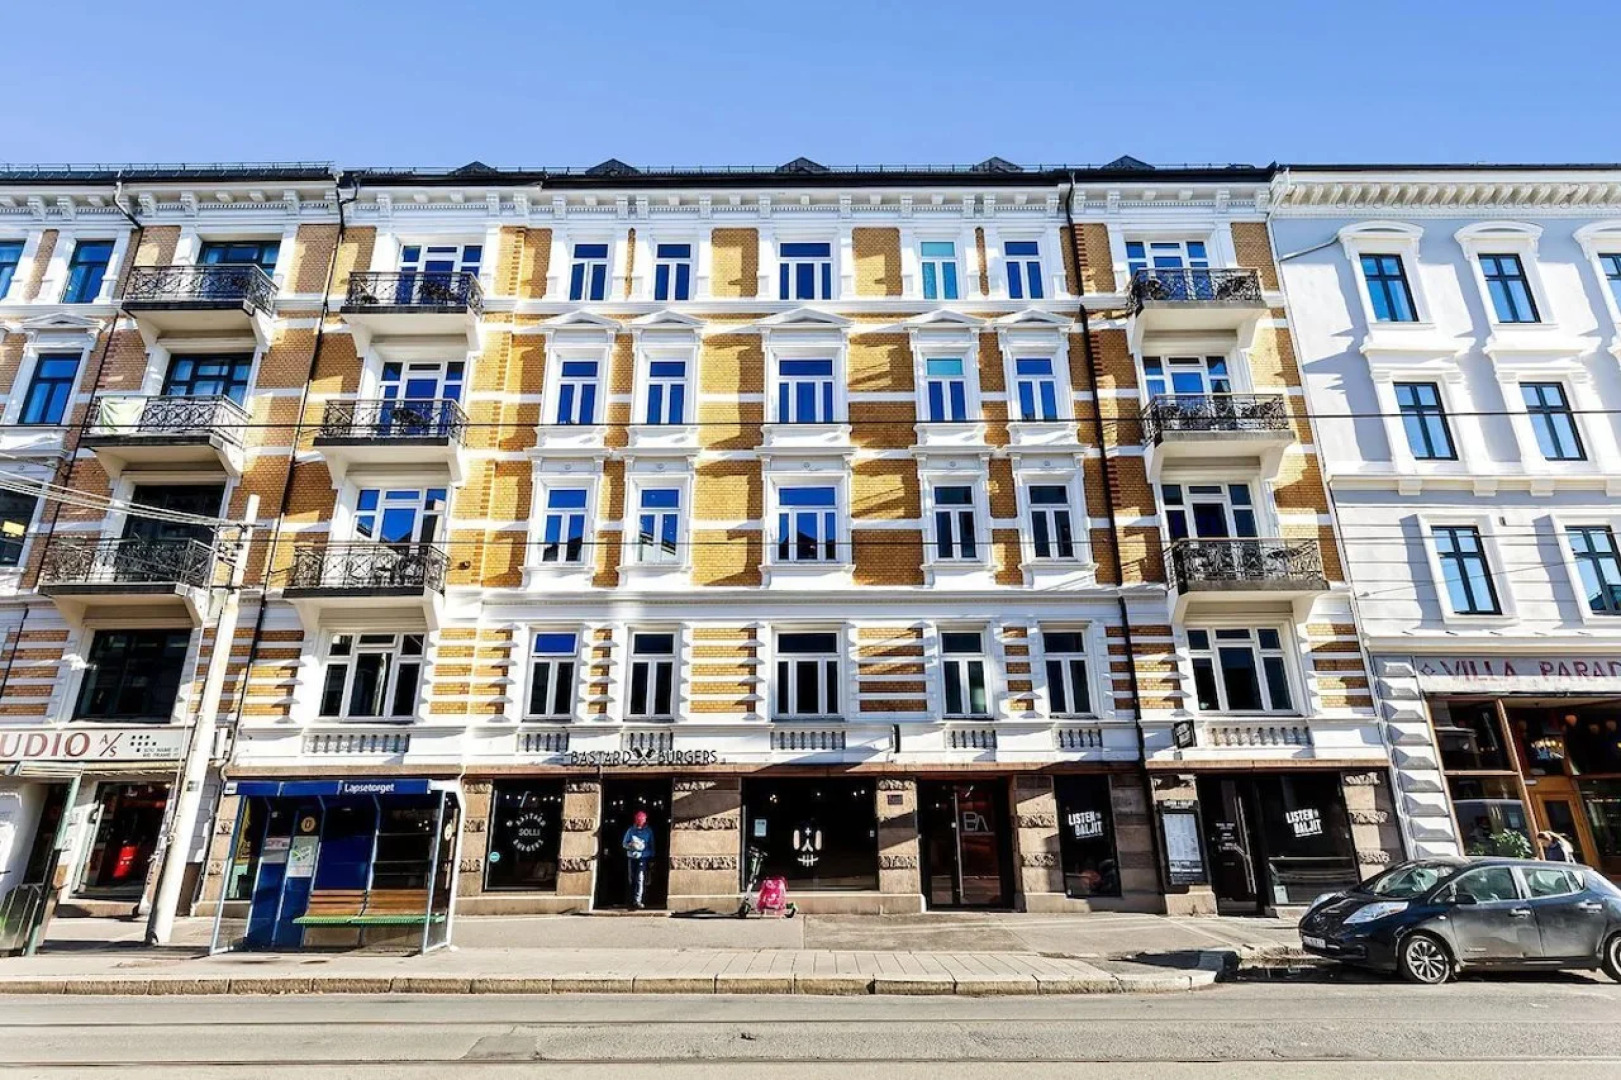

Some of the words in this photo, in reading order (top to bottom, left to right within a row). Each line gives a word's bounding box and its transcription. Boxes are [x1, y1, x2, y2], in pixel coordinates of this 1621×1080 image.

[1440, 660, 1517, 681] VILLA
[0, 732, 91, 758] UDIO
[571, 750, 631, 765] BASTARD
[657, 750, 718, 765] BURGERS
[344, 783, 395, 794] Lapsetorget
[1068, 811, 1096, 826] LISTEN
[1285, 808, 1314, 824] LISTEN
[518, 828, 541, 836] SOLLI
